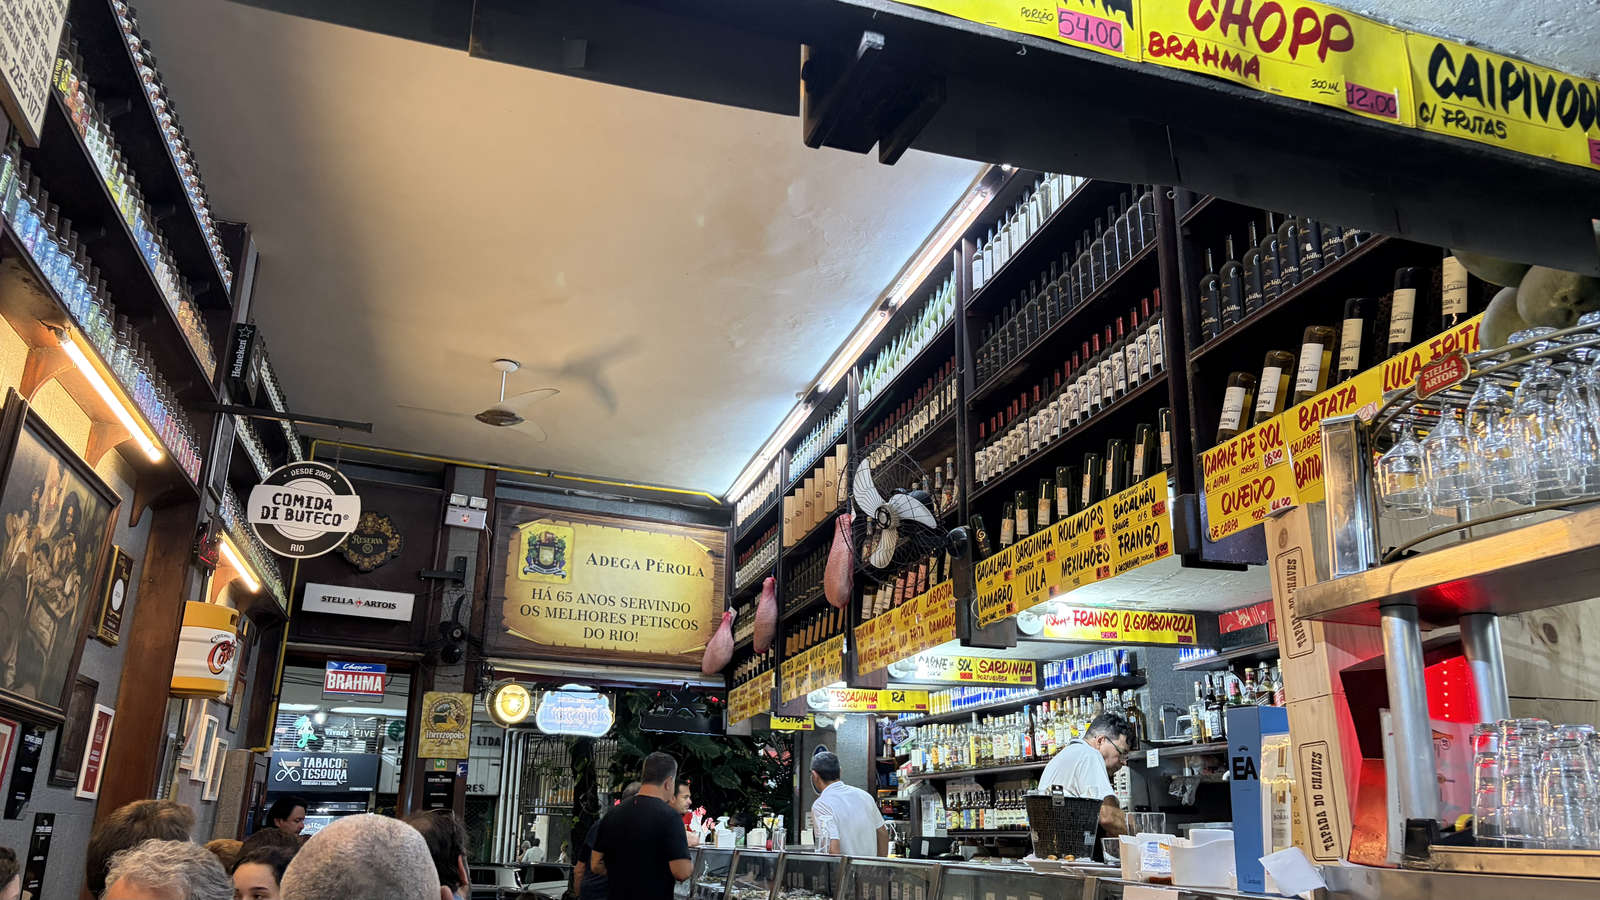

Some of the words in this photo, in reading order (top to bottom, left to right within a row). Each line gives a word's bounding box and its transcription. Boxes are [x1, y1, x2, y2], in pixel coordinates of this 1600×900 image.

[1059, 11, 1122, 49] 54.00
[1188, 0, 1354, 63] CHOPP
[1148, 31, 1260, 82] BRAHMA
[9, 57, 41, 123] 2253-1177
[1347, 82, 1396, 114] 12.00
[1428, 43, 1600, 133] CAIPIVOD
[1442, 108, 1508, 139] FRUTAS
[231, 338, 247, 378] Heineken
[1383, 352, 1421, 392] LULA
[1423, 360, 1457, 380] STELLA
[1425, 369, 1458, 390] ARTOIS
[1298, 384, 1357, 432] BATATA
[1204, 440, 1238, 478] CARNE
[1241, 432, 1256, 462] DE
[1259, 421, 1284, 452] SOL
[290, 467, 313, 477] DESDE
[315, 468, 332, 481] 2000
[1293, 454, 1323, 489] BATID
[272, 492, 333, 511] COMIDA
[1113, 486, 1156, 520] BACALHAU
[1221, 476, 1275, 515] QUEIJO
[260, 505, 278, 520] DI
[284, 508, 342, 527] BUTECO
[1058, 505, 1103, 543] ROLLMOPS
[290, 543, 305, 553] RIO
[1015, 529, 1053, 563] SARDINHA
[1117, 521, 1160, 558] FRANGO
[586, 552, 641, 571] ADEGA
[645, 557, 705, 578] PÉROLA
[977, 549, 1012, 583] BACALHAU
[1061, 543, 1110, 578] MEXILHÕES
[1025, 567, 1047, 596] LULA
[320, 595, 354, 606] STELLA
[364, 600, 398, 610] ARTOIS
[531, 586, 553, 601] HÁ
[556, 591, 572, 603] 65
[577, 592, 616, 607] ANOS
[620, 597, 691, 615] SERVINDO
[979, 584, 1013, 613] CAMARÃO
[520, 604, 540, 617] OS
[545, 606, 627, 626] MELHORES
[631, 615, 699, 631] PETISCOS
[1072, 610, 1118, 628] FRANGO
[583, 626, 605, 640] DO
[609, 629, 639, 643] RIO!
[958, 659, 973, 672] SOL
[978, 659, 1033, 675] SARDINHA
[326, 672, 382, 692] BRAHMA
[354, 729, 376, 737] FIVE
[476, 735, 501, 748] LTDA
[301, 768, 348, 784] TESOURA
[303, 757, 341, 769] TABACO
[1311, 751, 1323, 789] CHAVES
[1315, 794, 1325, 807] DO
[1317, 809, 1335, 853] TAPADA
